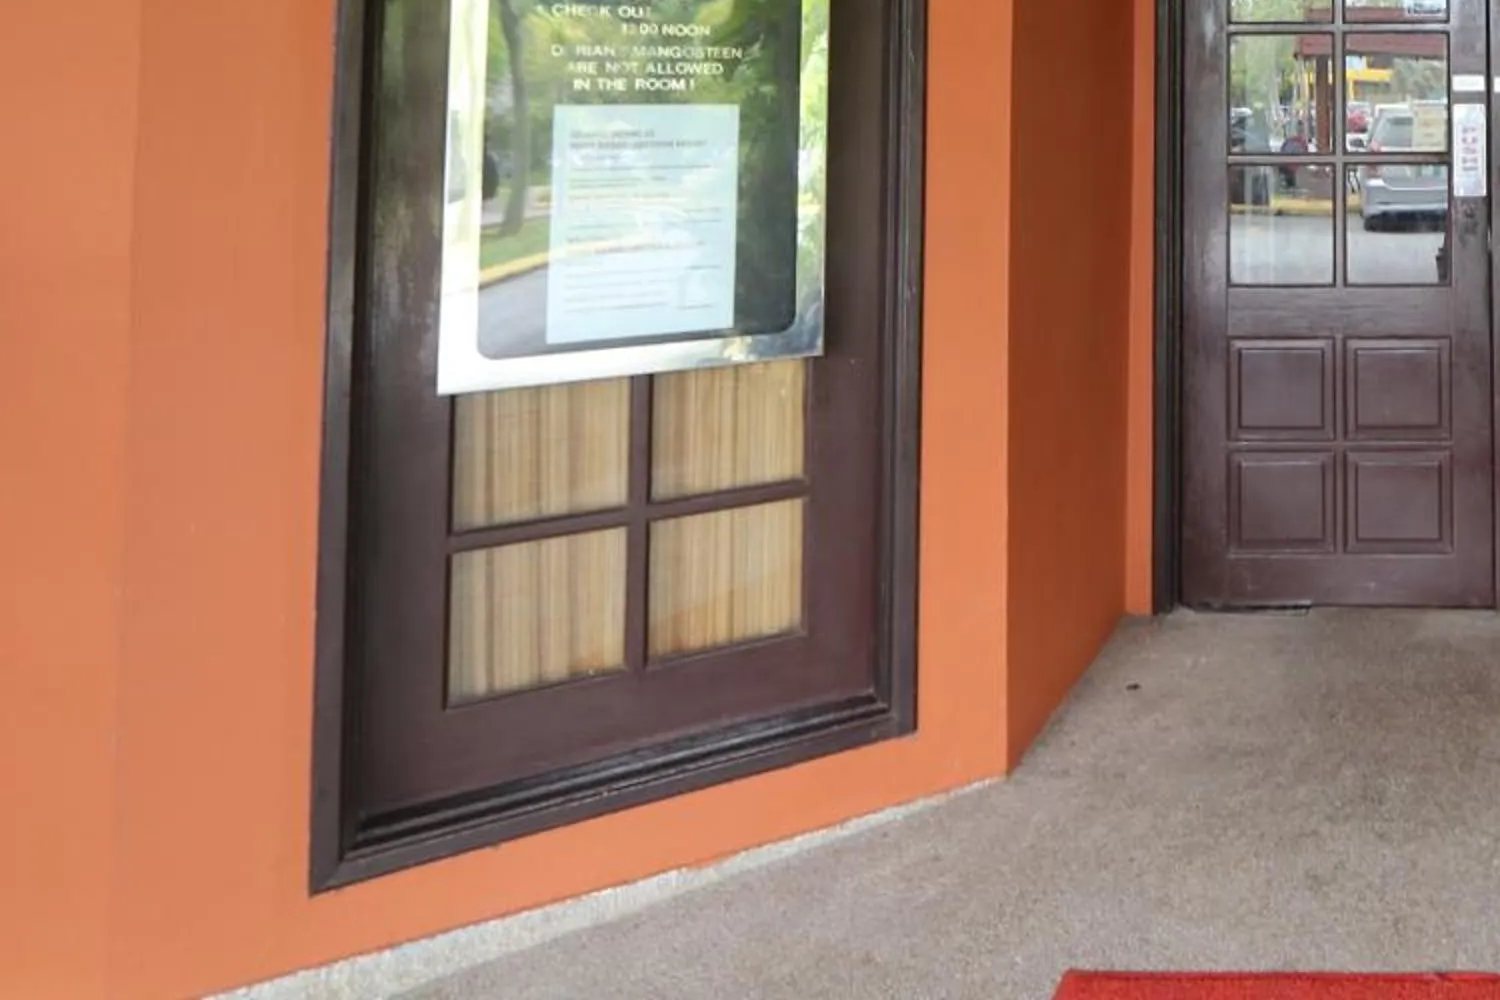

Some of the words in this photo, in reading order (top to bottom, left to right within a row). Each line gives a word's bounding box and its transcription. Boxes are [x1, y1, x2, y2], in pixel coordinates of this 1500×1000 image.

[551, 4, 611, 18] CHECK
[661, 24, 711, 37] NOON
[551, 44, 616, 57] DRIAN
[632, 46, 742, 60] MANGOSTEEN
[568, 61, 598, 75] ARE
[605, 61, 639, 75] NOT
[646, 62, 724, 75] ALLOWED
[573, 78, 591, 91] IN
[597, 78, 628, 91] THE
